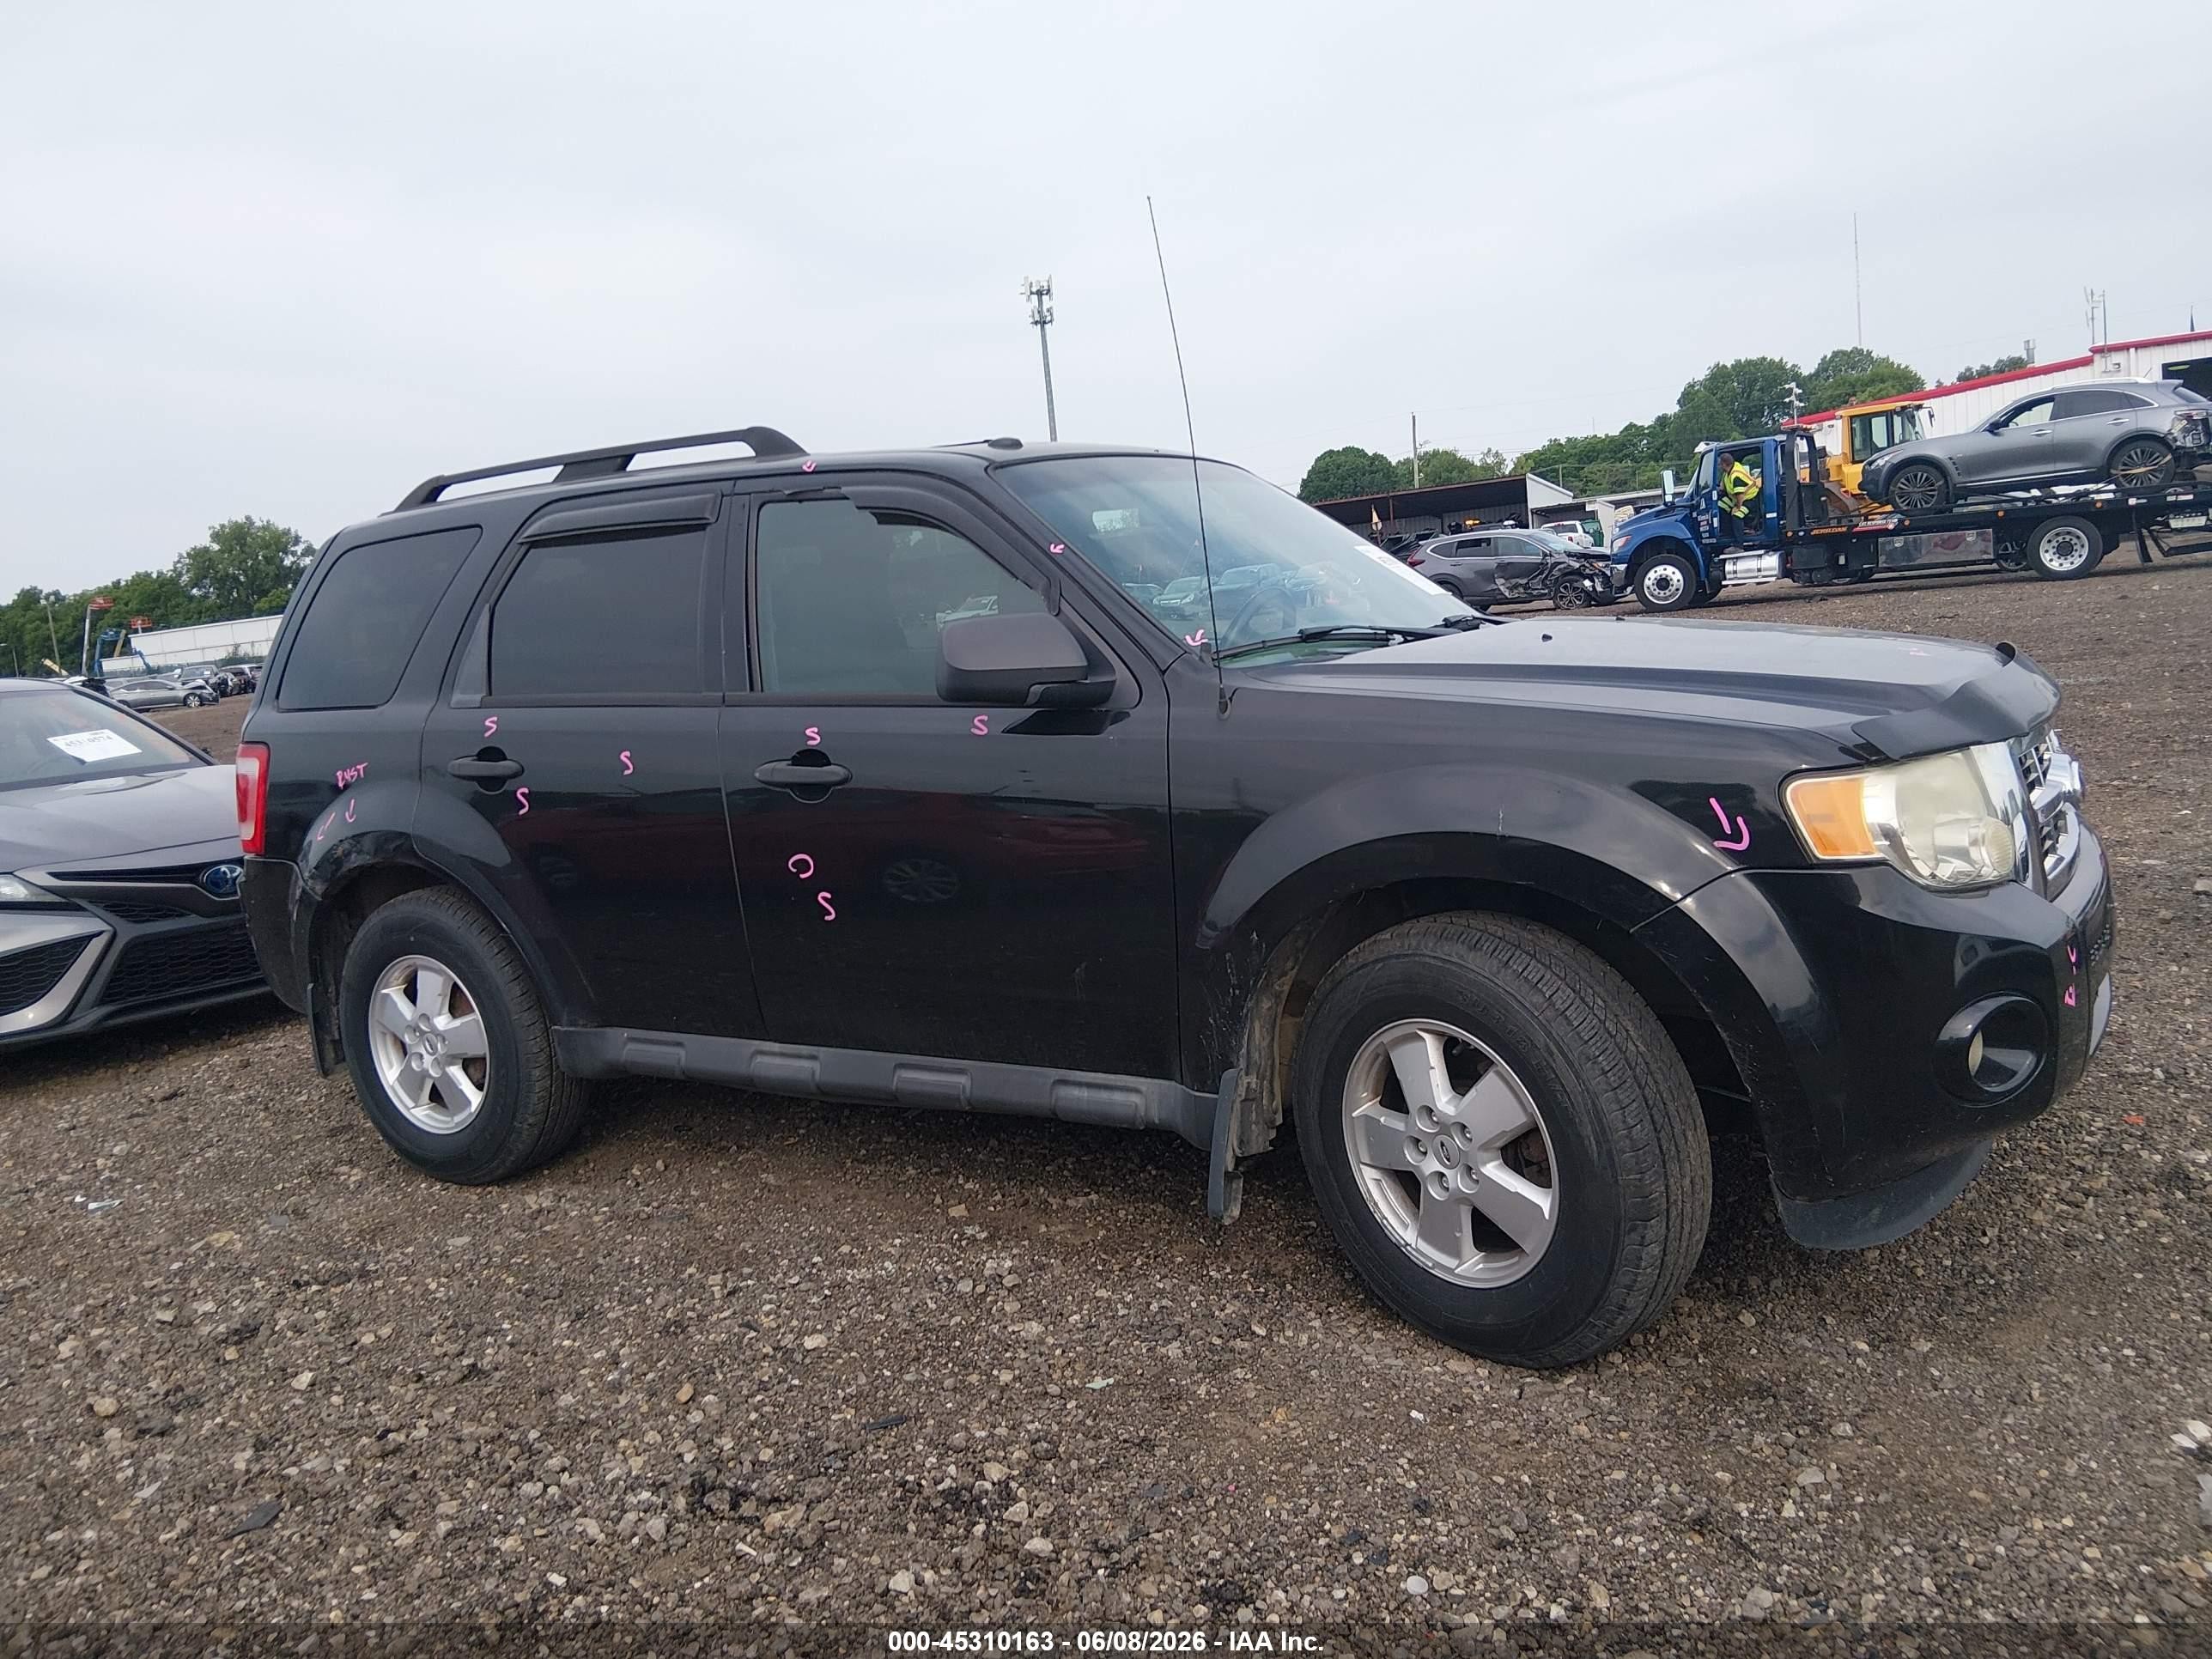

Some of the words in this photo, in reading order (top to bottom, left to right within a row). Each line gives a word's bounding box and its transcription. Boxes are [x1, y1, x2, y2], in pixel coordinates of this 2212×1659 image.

[484, 716, 498, 737] S
[805, 726, 821, 746] S
[970, 714, 988, 736] S
[619, 750, 634, 776] S
[516, 787, 530, 816] S
[817, 890, 837, 922] S
